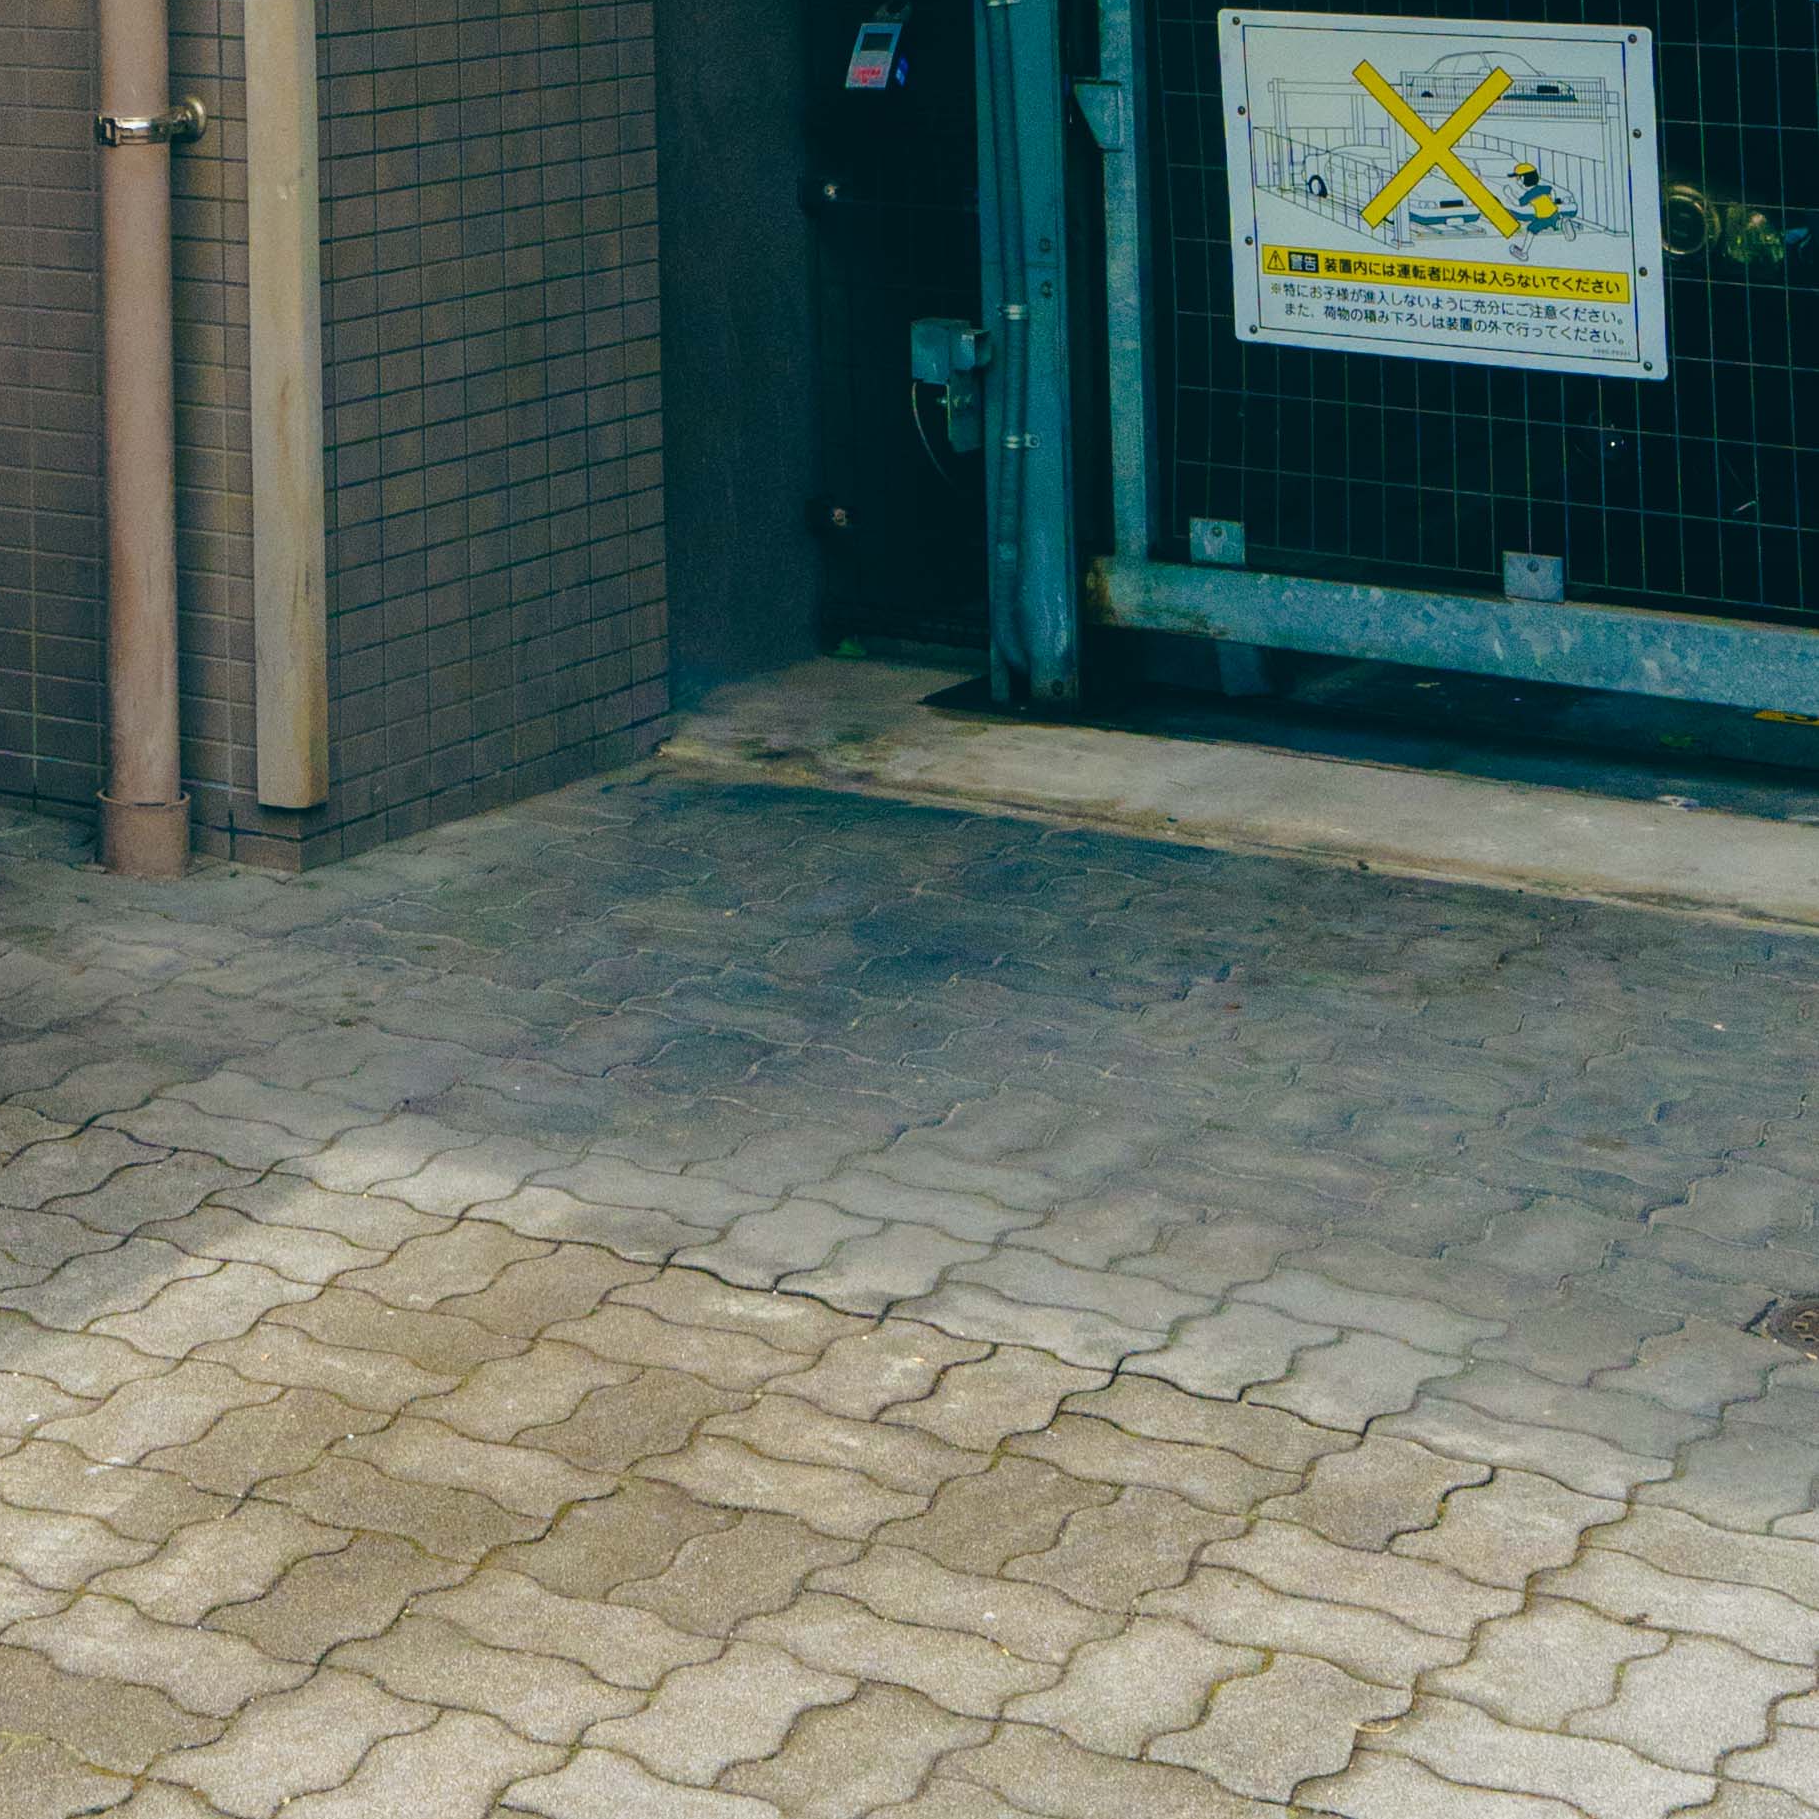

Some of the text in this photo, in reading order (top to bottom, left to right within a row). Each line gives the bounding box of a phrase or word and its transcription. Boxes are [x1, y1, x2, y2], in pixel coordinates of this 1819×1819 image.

[1289, 253, 1621, 295] 警告 装置内には運転者以外は入らないでください
[1270, 283, 1624, 326] ※特にお子様が進入しないように充分にご注意ください。
